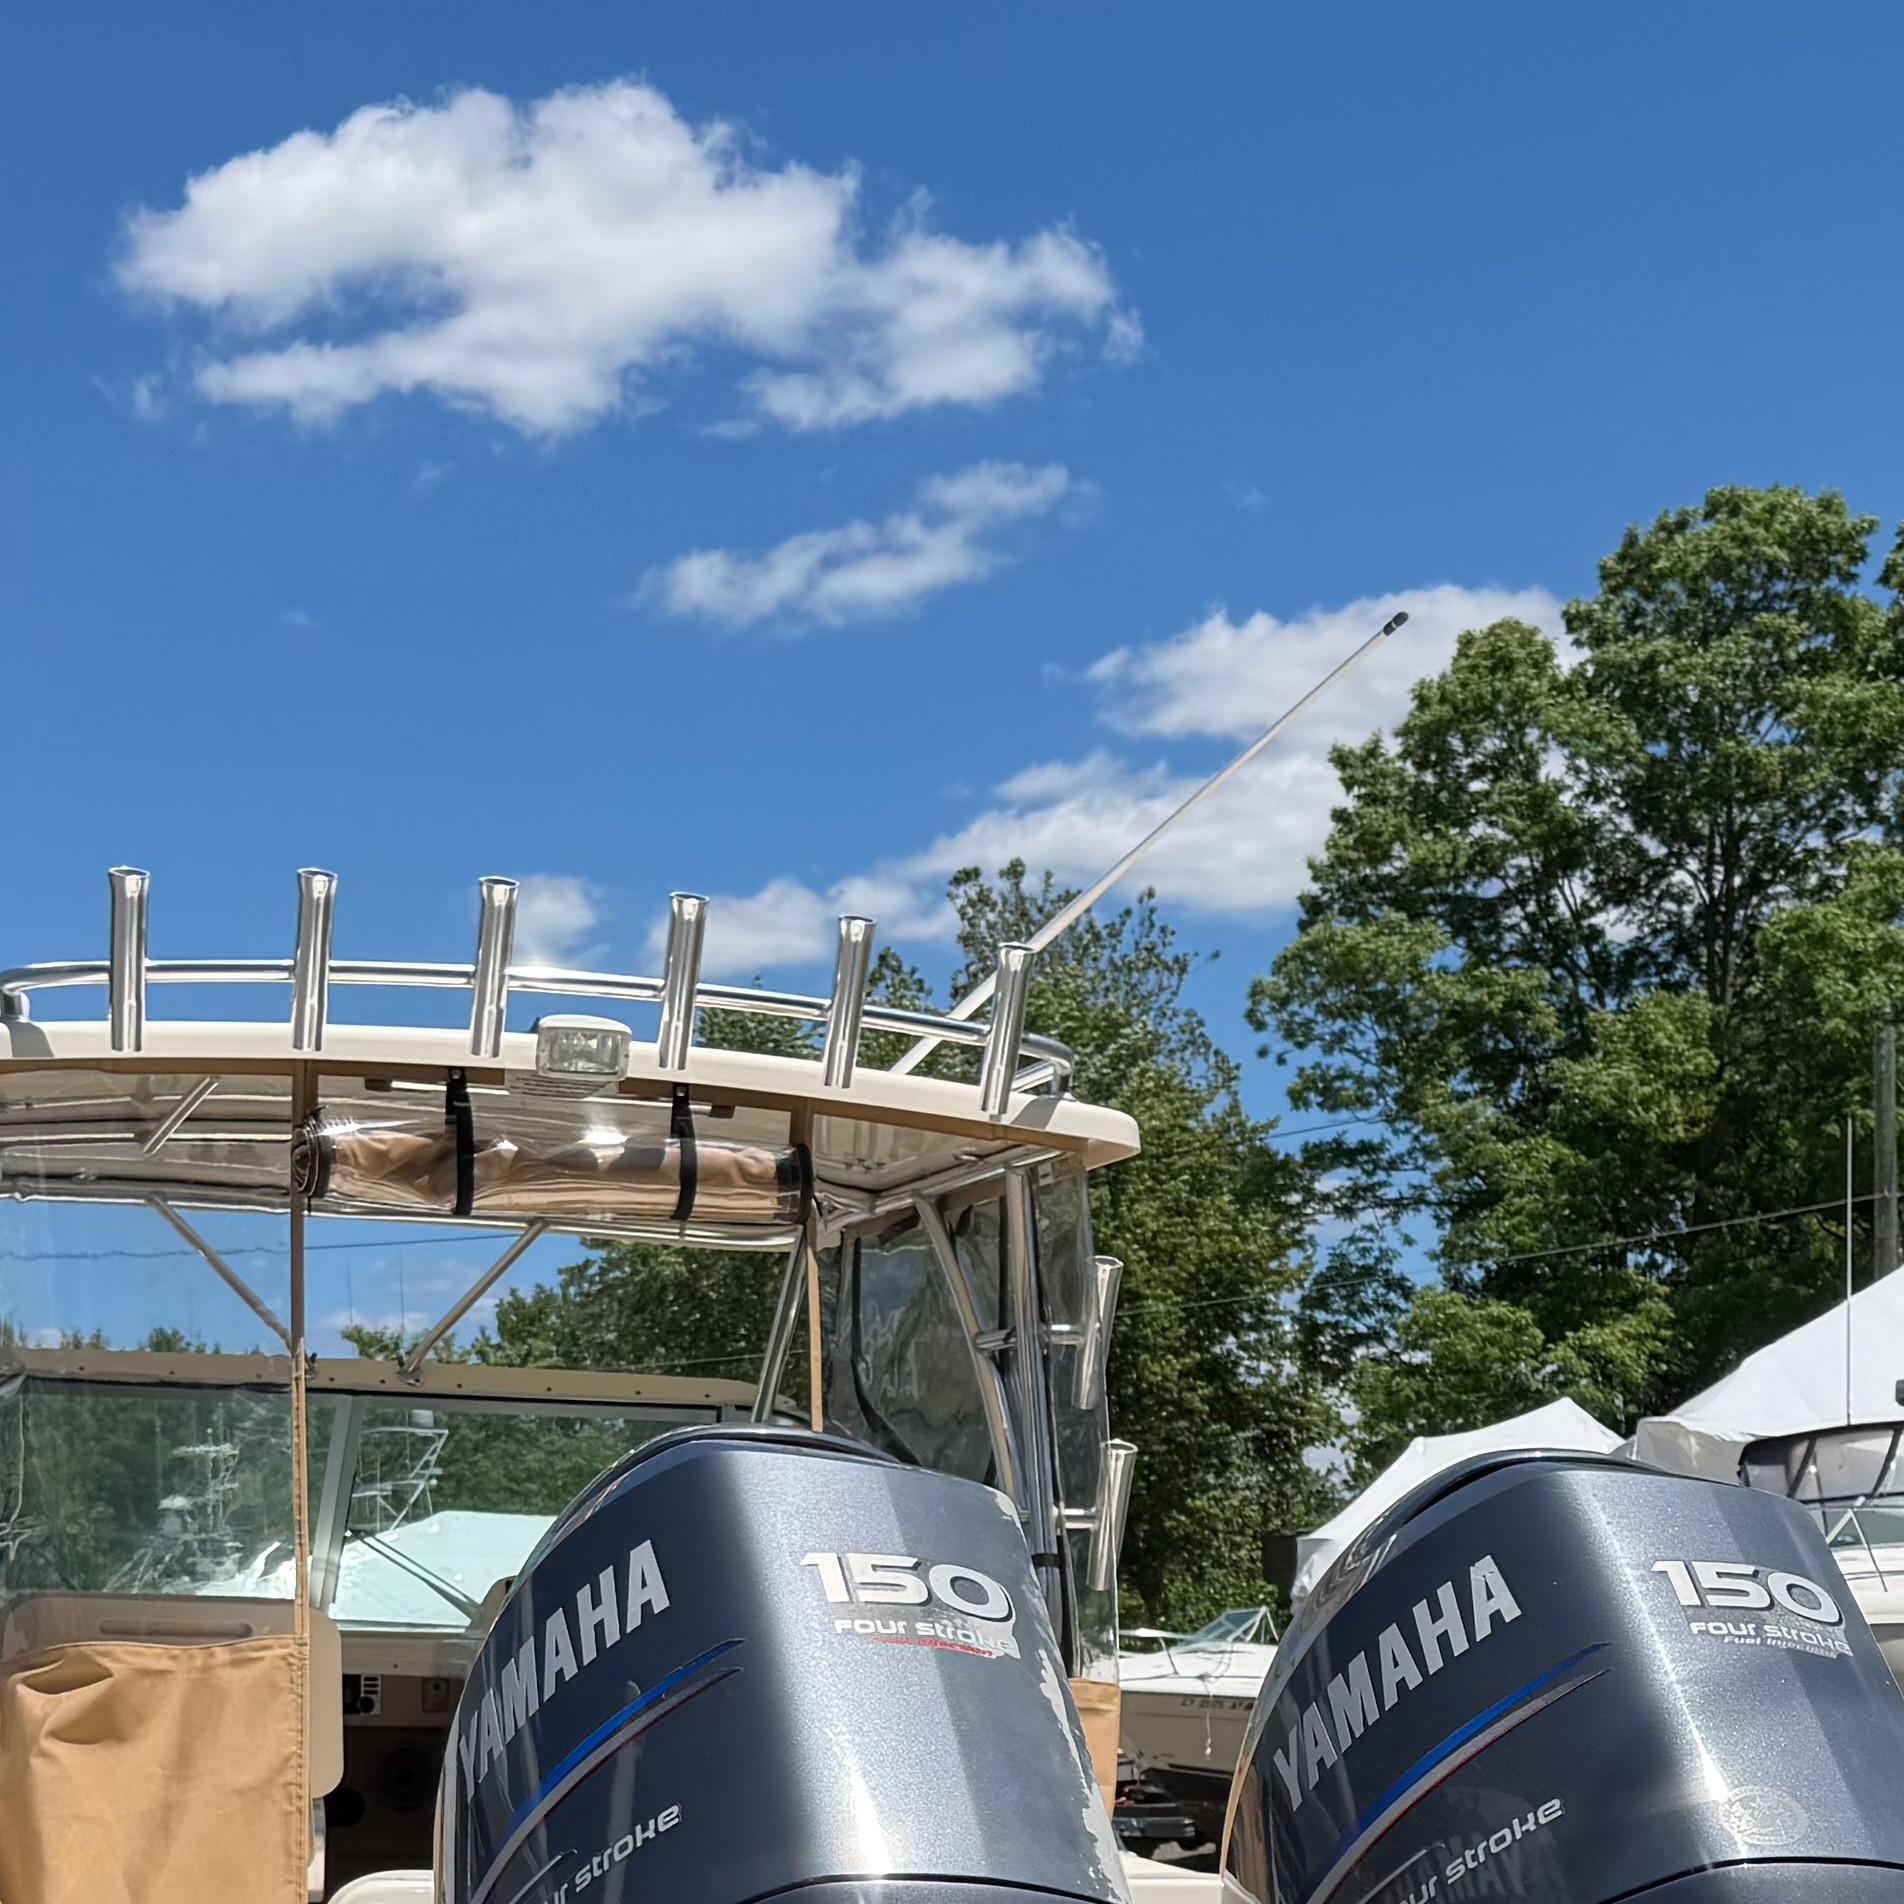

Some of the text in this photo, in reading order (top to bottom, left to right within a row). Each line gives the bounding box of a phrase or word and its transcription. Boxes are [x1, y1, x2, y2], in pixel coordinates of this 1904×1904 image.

[800, 1552, 1014, 1622] 150
[1651, 1560, 1844, 1626] 150
[459, 1538, 670, 1802] YAMAHA
[1273, 1554, 1522, 1813] YAMAHA
